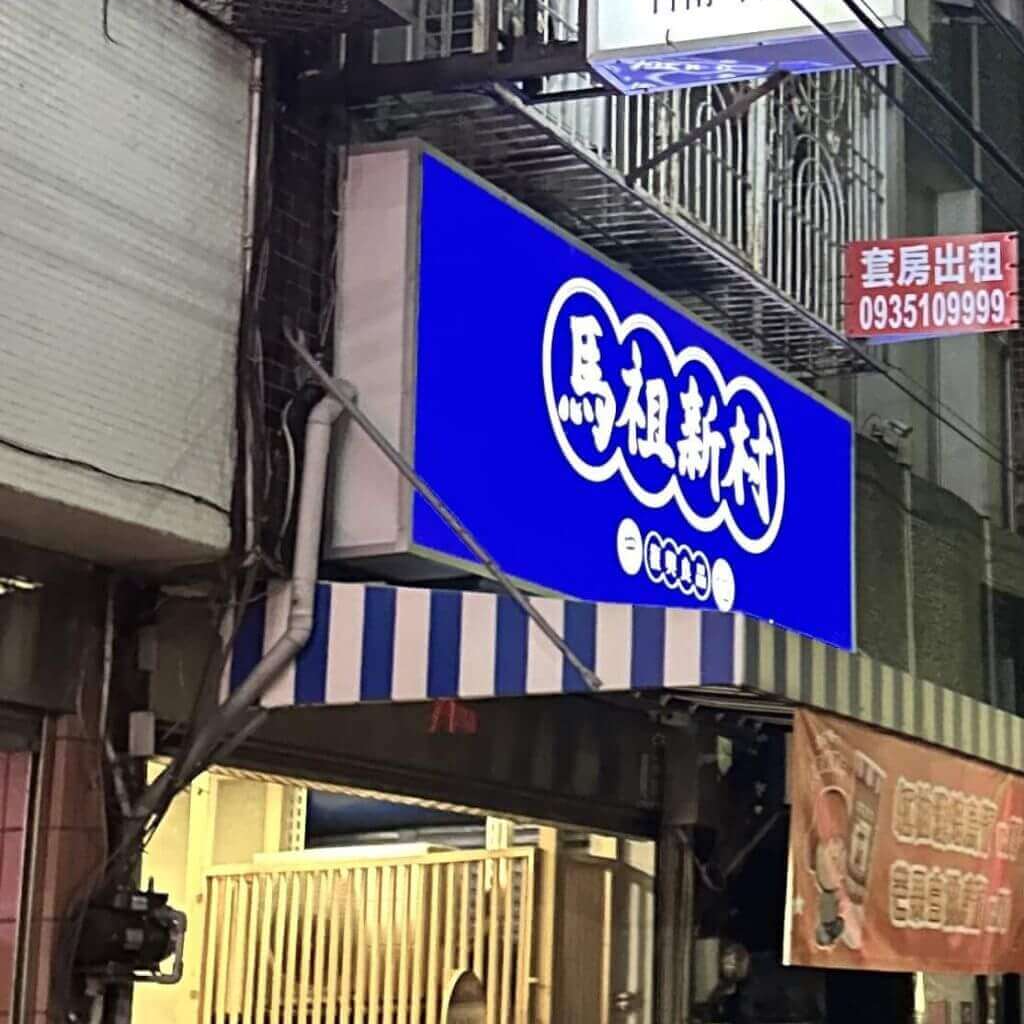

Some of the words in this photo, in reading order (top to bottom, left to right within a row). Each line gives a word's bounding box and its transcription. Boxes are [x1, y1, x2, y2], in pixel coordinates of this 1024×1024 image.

[859, 241, 1004, 289] 套房出租
[859, 288, 1005, 330] 0935109999
[558, 315, 774, 525] 馬祖新村
